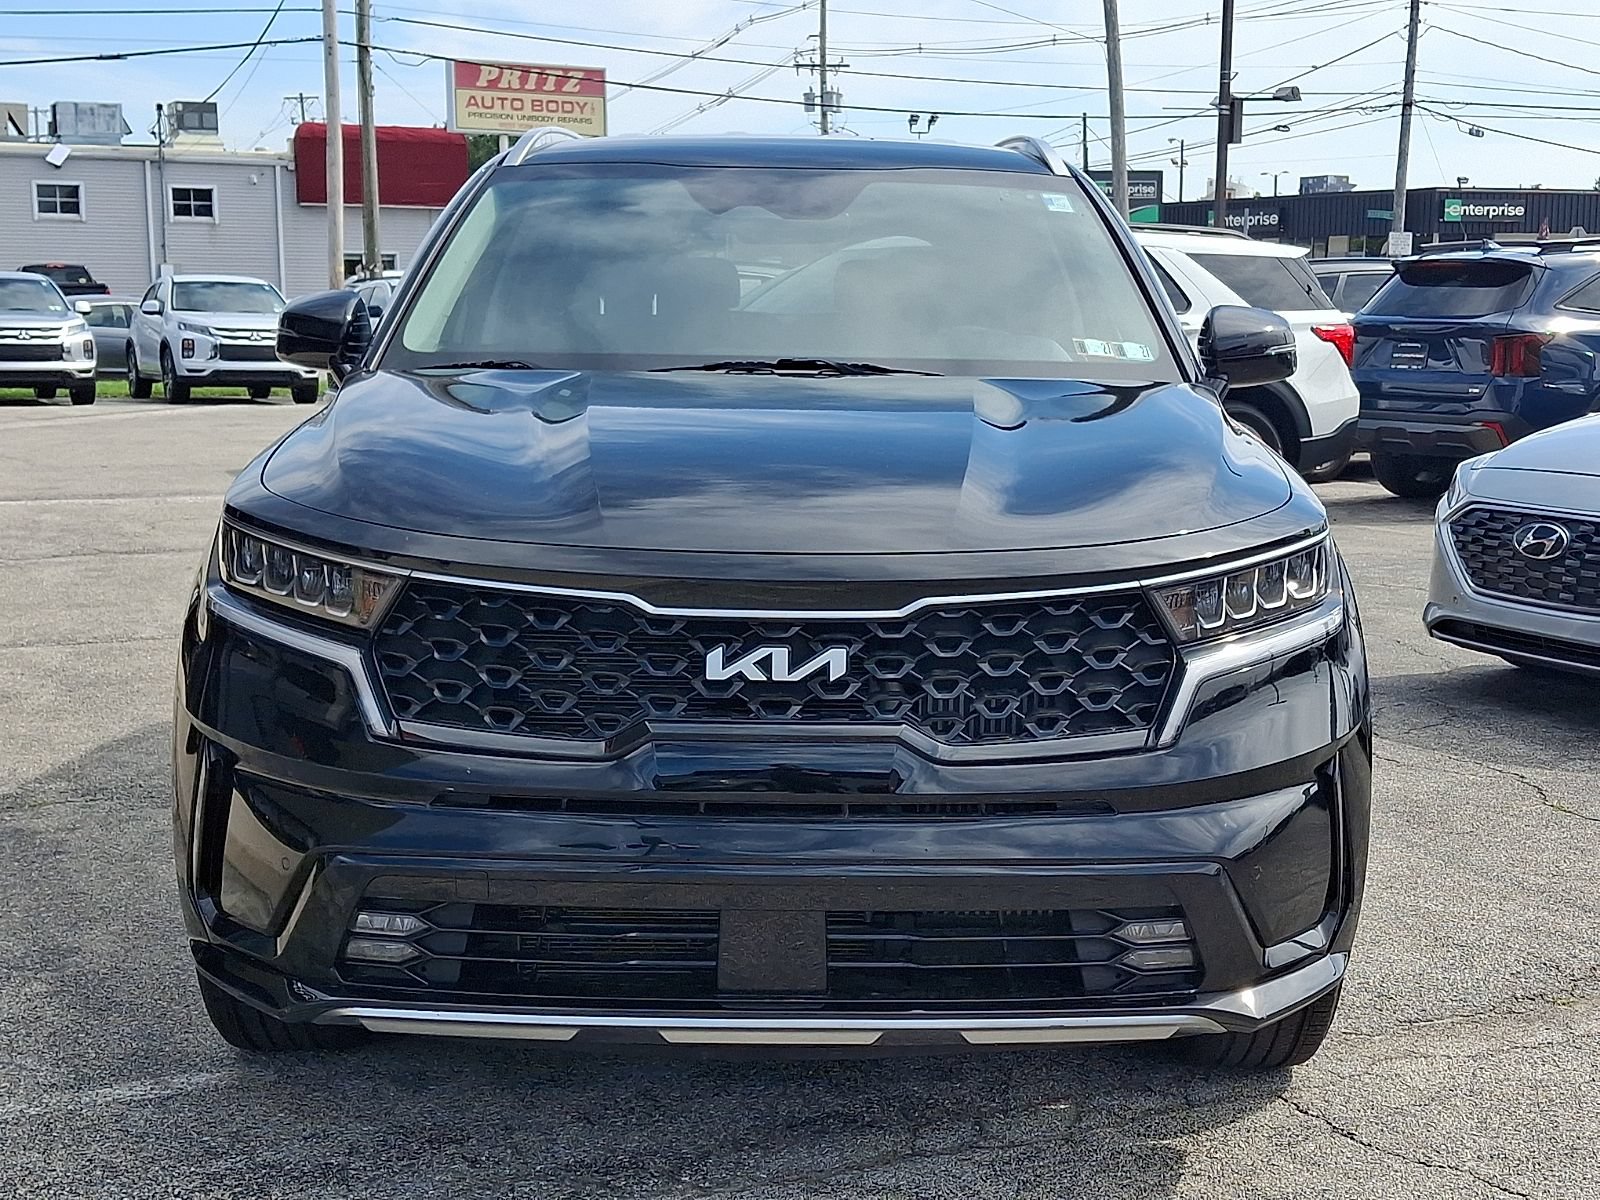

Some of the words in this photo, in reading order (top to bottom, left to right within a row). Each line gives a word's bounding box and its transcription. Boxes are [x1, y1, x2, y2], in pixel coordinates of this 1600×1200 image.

[476, 65, 585, 93] PRITZ
[465, 95, 525, 111] AUTO
[531, 99, 588, 115] BODY
[467, 111, 513, 121] PRECISION
[516, 114, 555, 123] UNIBODY
[557, 117, 593, 125] REPAIRS
[1447, 203, 1525, 219] enterprise
[706, 646, 847, 682] KIA
